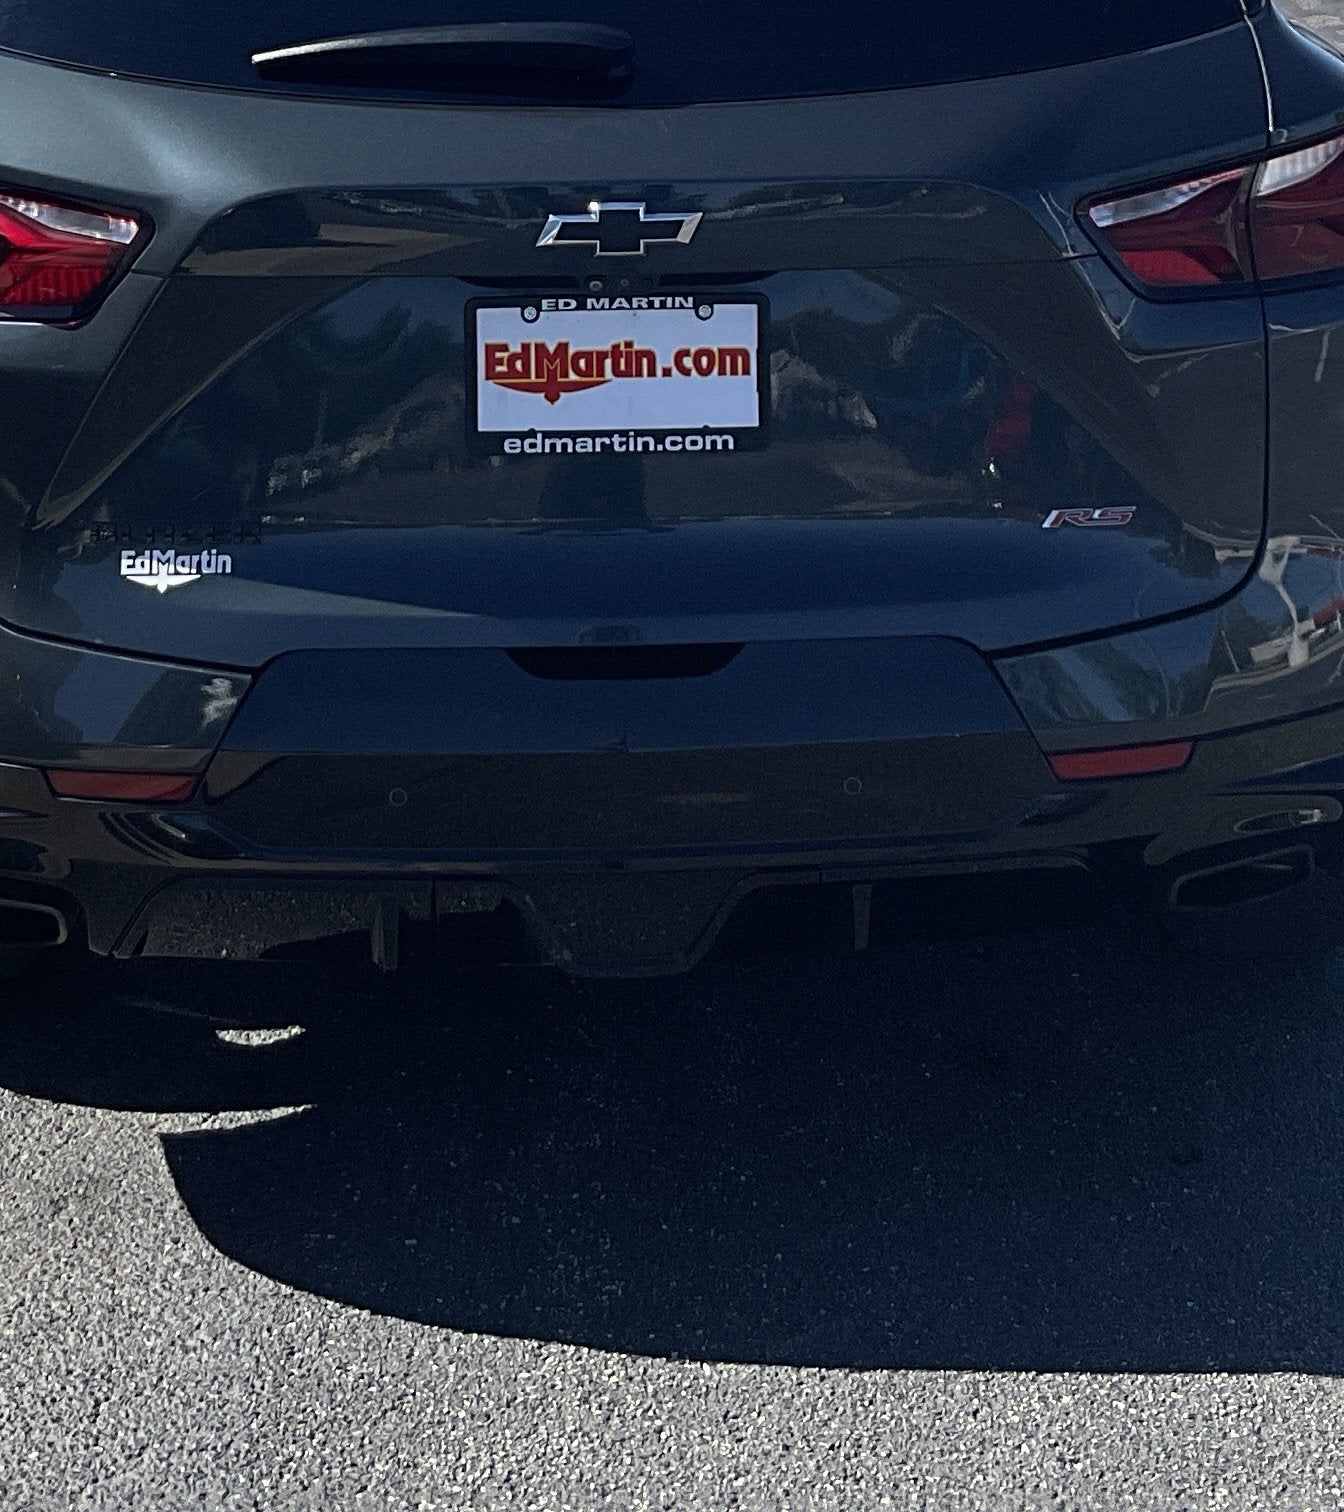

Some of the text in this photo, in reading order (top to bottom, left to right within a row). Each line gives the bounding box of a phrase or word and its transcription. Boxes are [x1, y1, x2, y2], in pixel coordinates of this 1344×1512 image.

[541, 296, 694, 311] ED MARTIN
[484, 340, 751, 382] EdMartin.com
[503, 430, 735, 454] edmartin.com
[1042, 505, 1137, 528] RS
[120, 548, 232, 575] EdMartin
